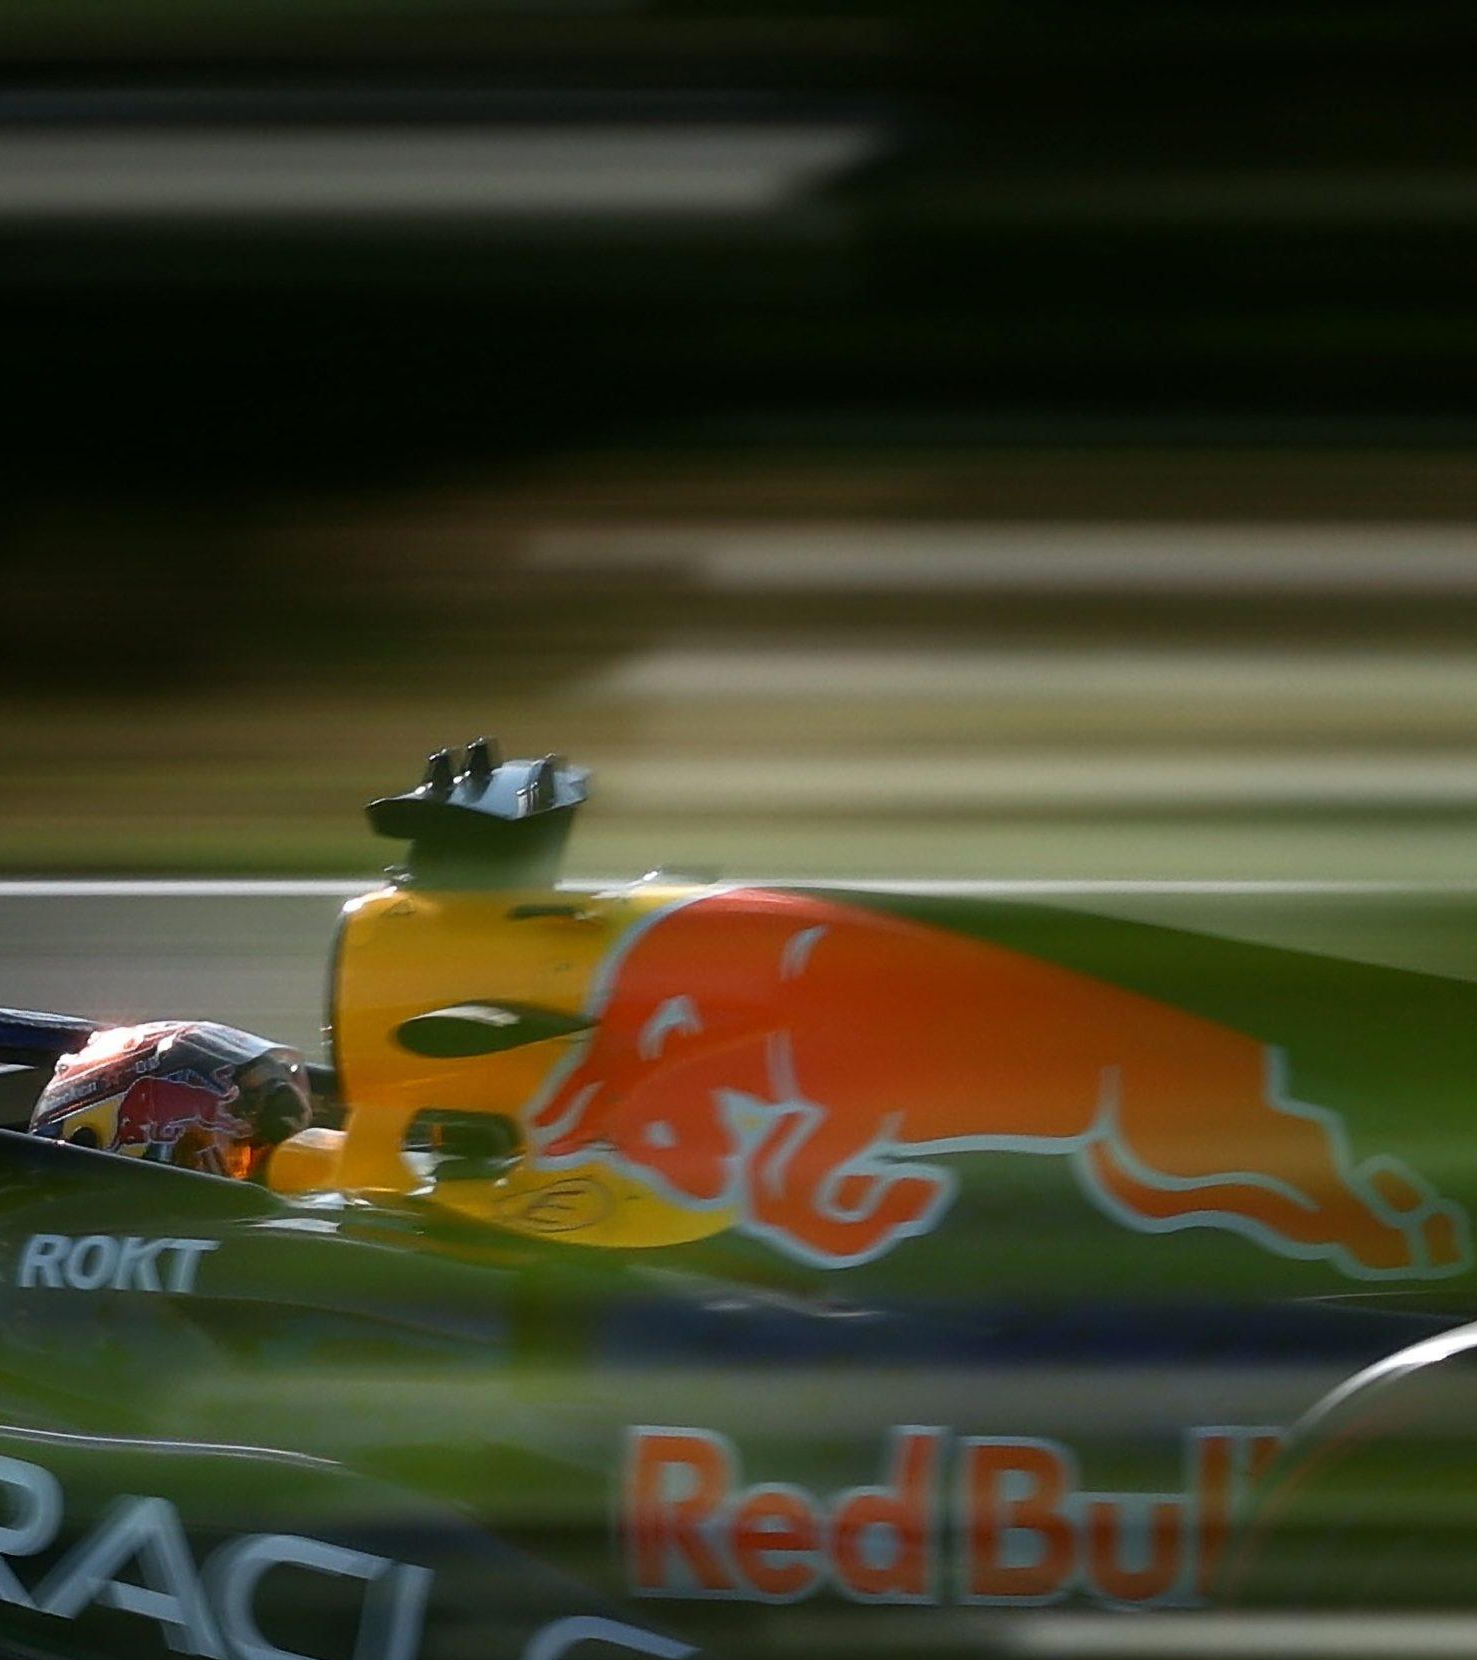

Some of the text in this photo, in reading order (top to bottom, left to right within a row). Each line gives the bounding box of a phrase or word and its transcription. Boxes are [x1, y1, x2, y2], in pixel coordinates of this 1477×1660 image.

[19, 1233, 221, 1294] ROKT
[626, 1427, 1284, 1606] Red Bul
